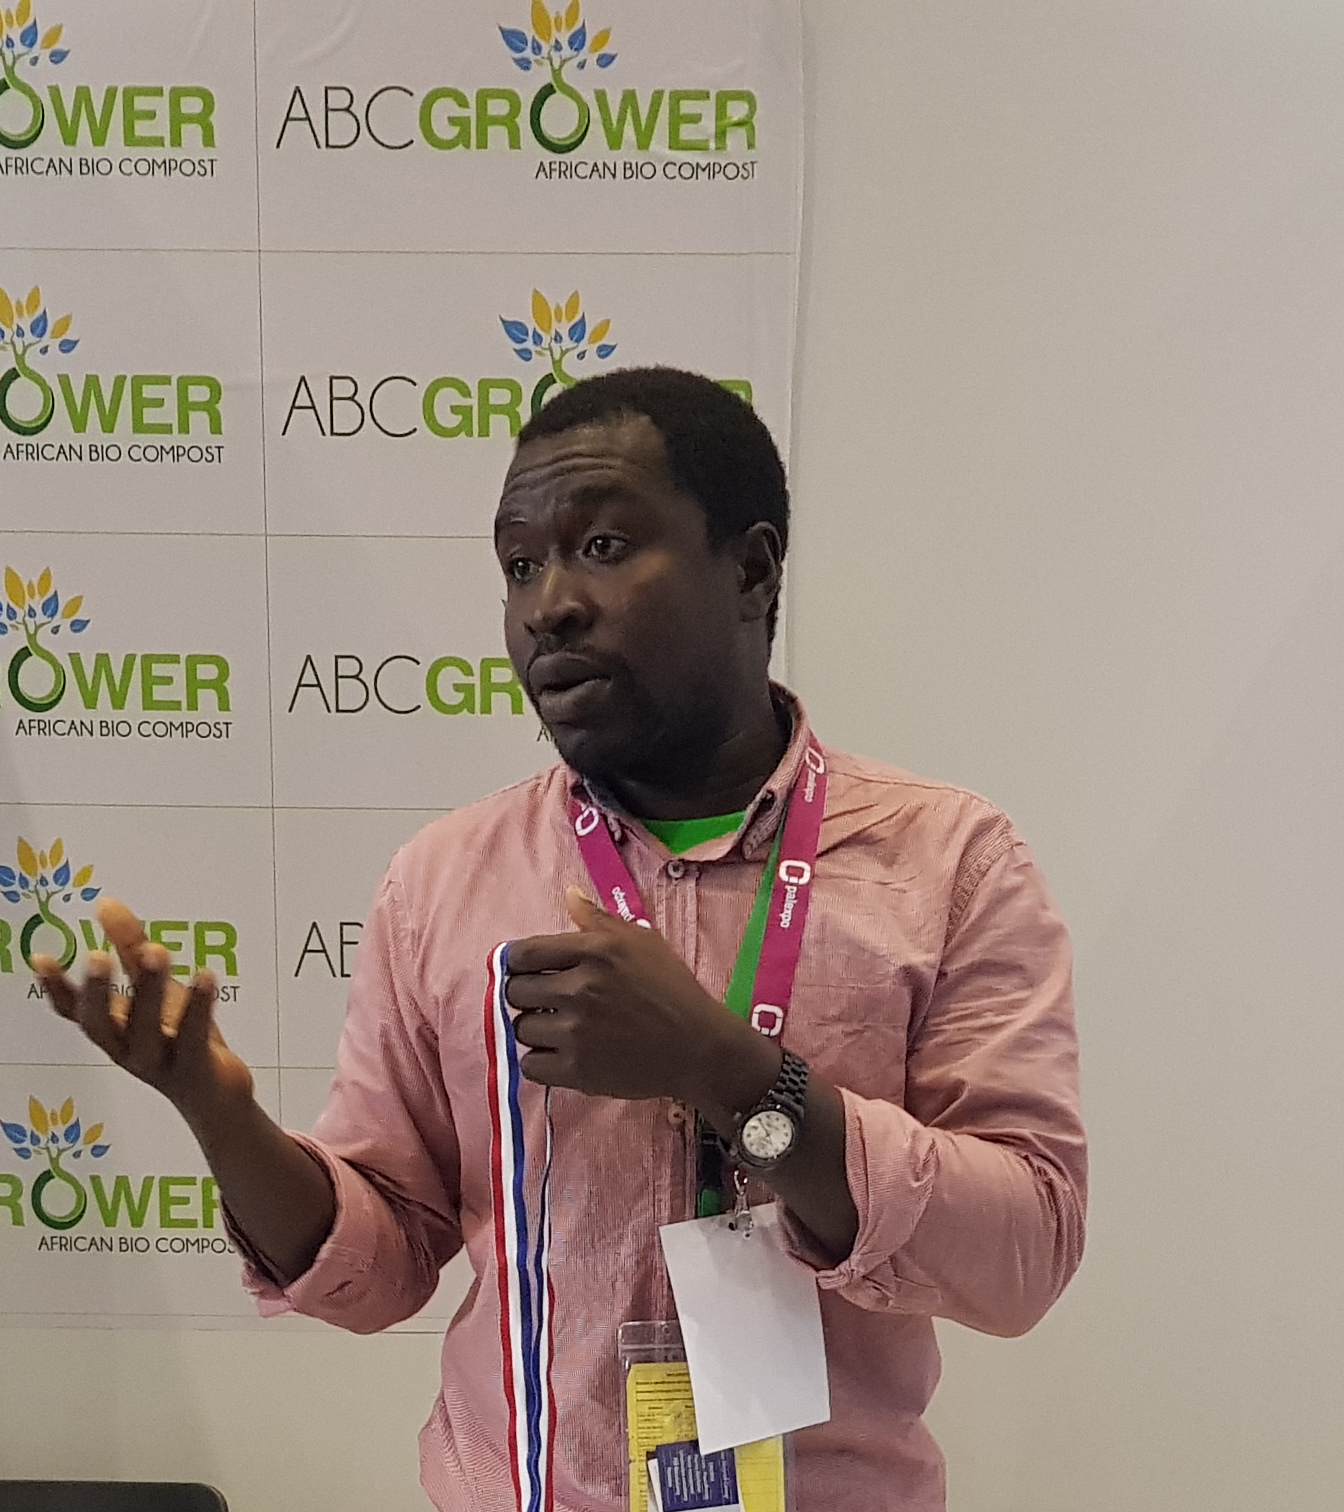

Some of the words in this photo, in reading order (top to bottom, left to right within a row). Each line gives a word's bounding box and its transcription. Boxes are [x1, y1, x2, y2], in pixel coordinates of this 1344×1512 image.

[276, 82, 757, 153] ABCGROWER
[78, 158, 112, 178] BIO
[117, 158, 217, 179] COMPOST
[535, 161, 617, 181] AFRICAN
[621, 162, 656, 181] BIO
[661, 162, 757, 182] COMPOST
[2, 442, 83, 463] AFRICAN
[87, 444, 121, 463] BIO
[127, 444, 224, 465] COMPOST
[15, 719, 93, 738] AFRICAN
[98, 719, 131, 738] BIO
[137, 719, 232, 740] COMPOST
[780, 885, 797, 928] palexpo
[38, 1235, 115, 1254] AFRICAN
[119, 1237, 150, 1254] BIO
